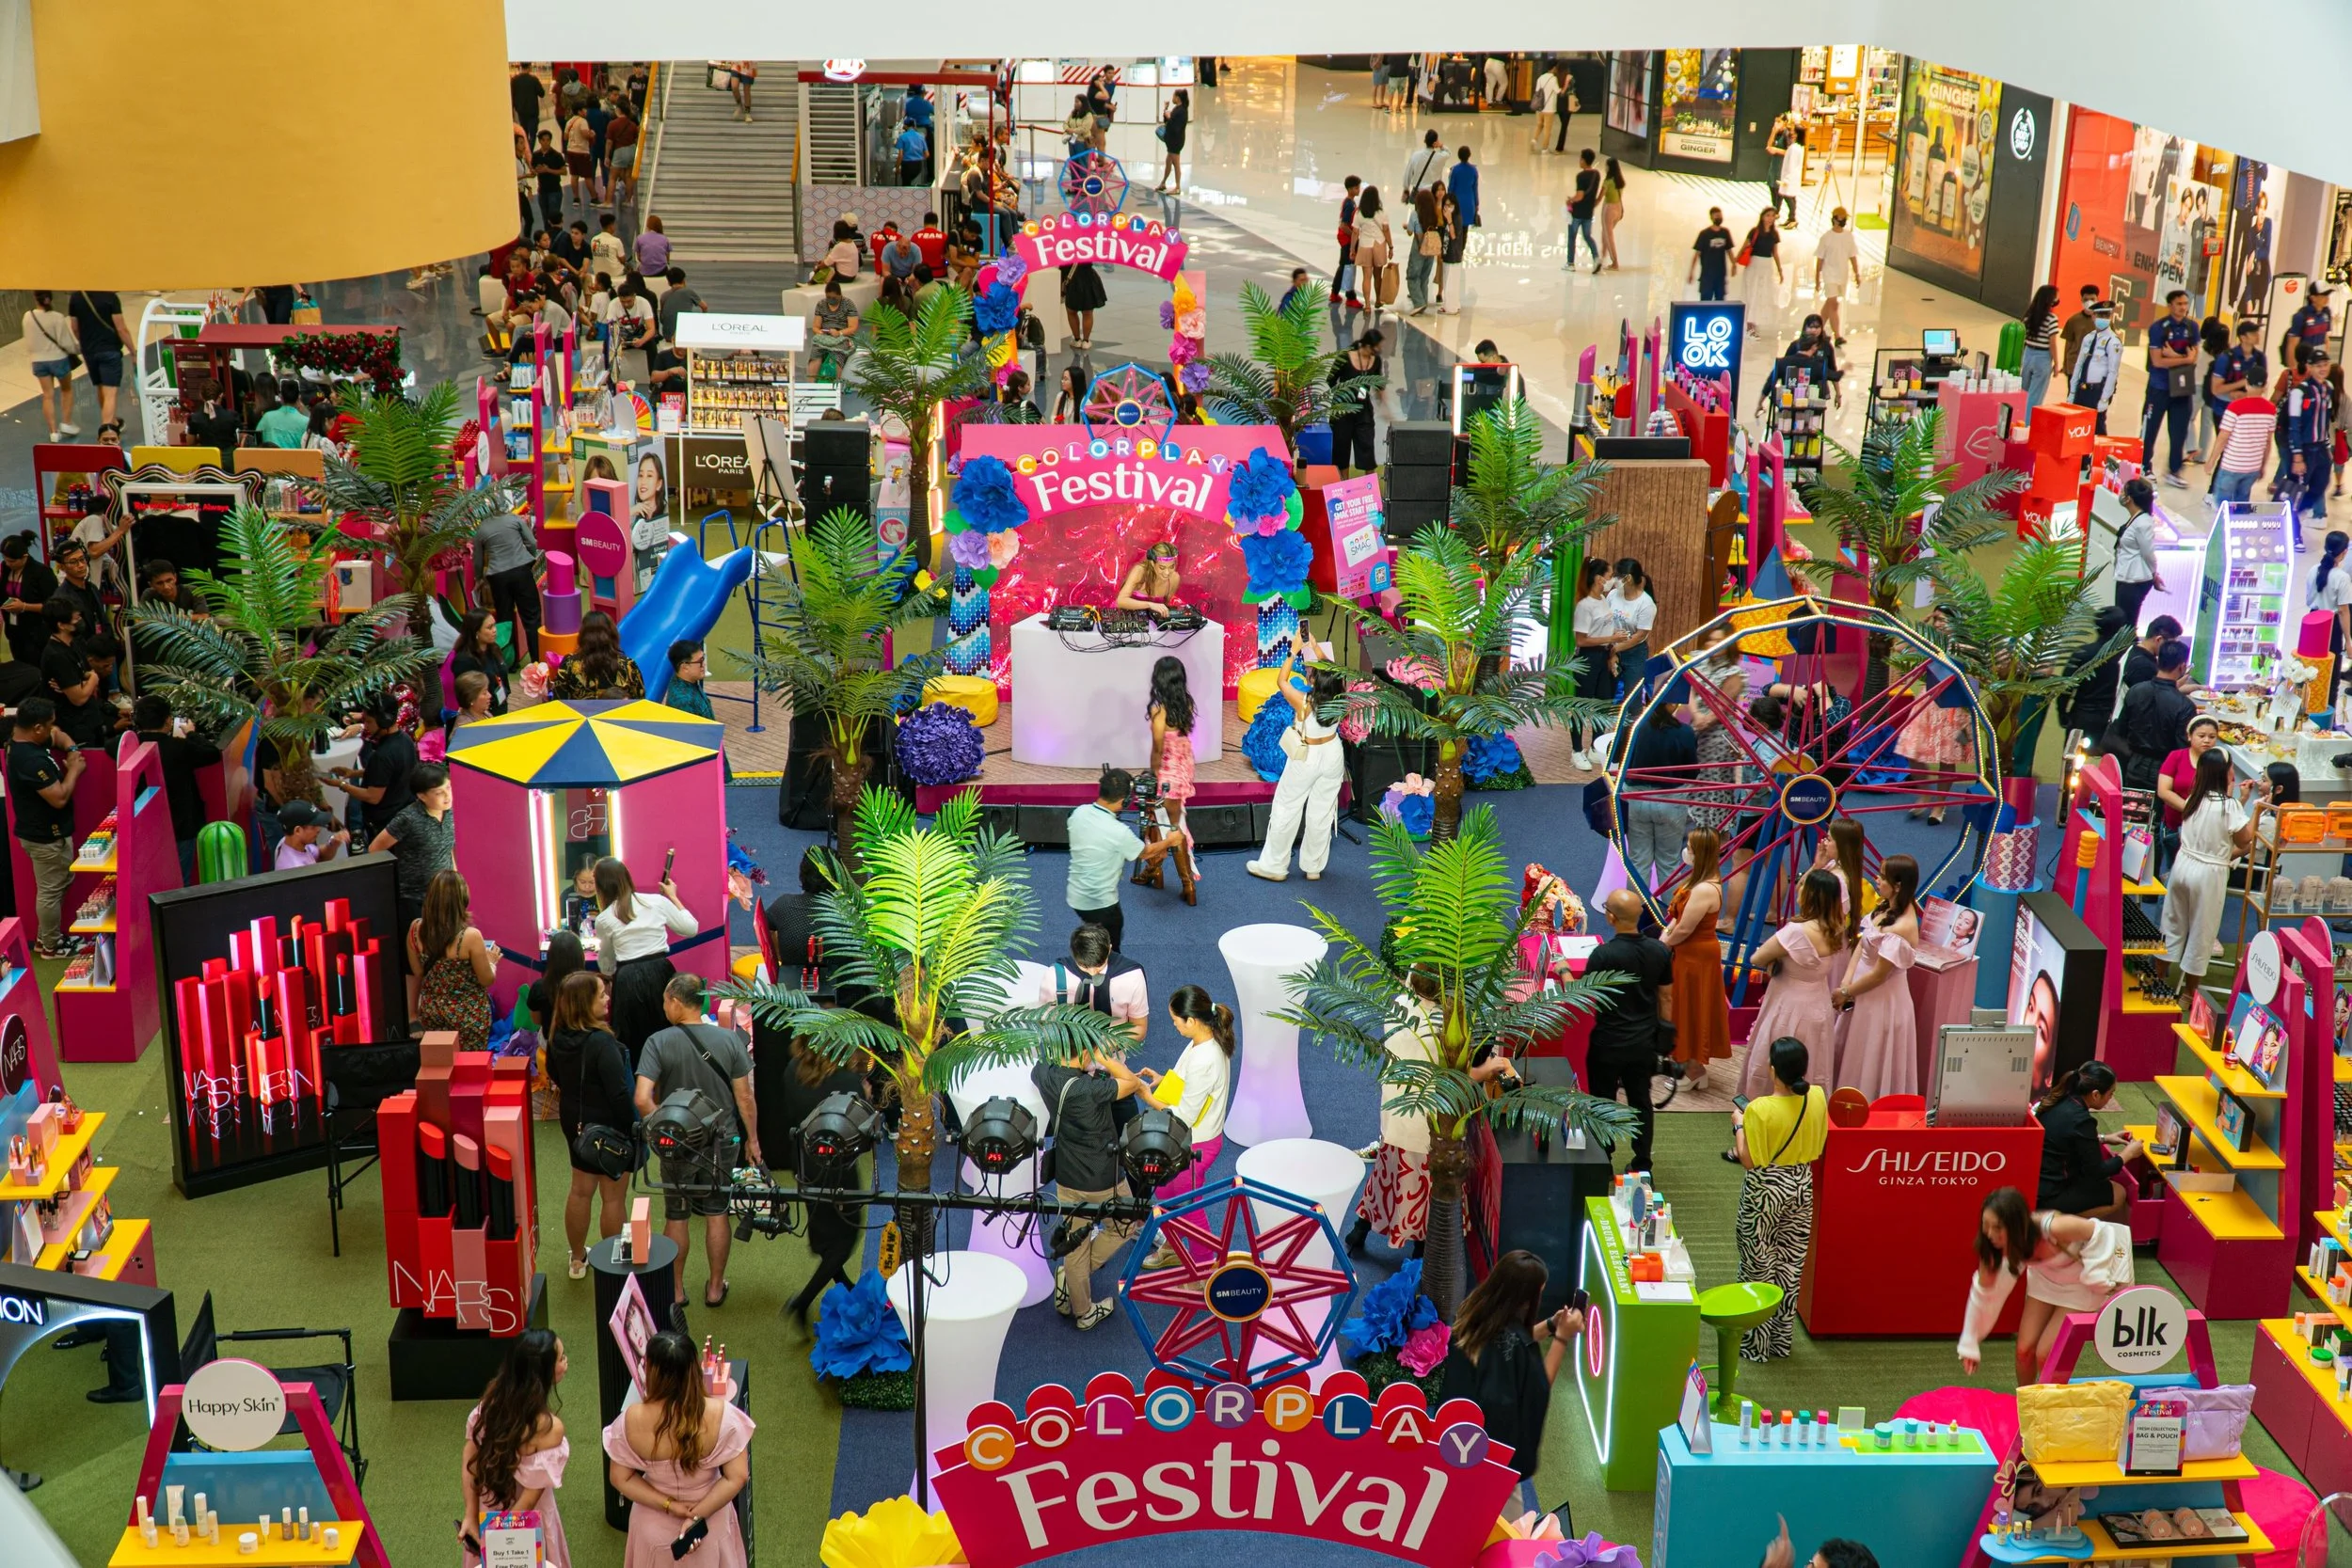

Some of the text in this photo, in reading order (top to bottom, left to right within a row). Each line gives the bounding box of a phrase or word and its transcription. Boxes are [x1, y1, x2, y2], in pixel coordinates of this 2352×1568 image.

[1929, 83, 1979, 111] GINGER
[1680, 144, 1716, 154] GINGER
[1025, 214, 1179, 243] COLORPLAY
[1032, 230, 1168, 273] Festival
[2133, 251, 2185, 284] ENHYPEN
[695, 454, 751, 467] L'ORÉA
[1018, 439, 1226, 474] COLORPLAY
[1029, 462, 1214, 513] Festival
[1346, 499, 1362, 509] YOUR
[1362, 495, 1375, 506] FREE
[1349, 507, 1365, 518] START
[580, 537, 621, 552] SMBEAUTY
[1350, 539, 1372, 556] SMAC
[2251, 952, 2277, 981] SHISEIDO
[1846, 1148, 2006, 1173] SHISEIDO
[1879, 1176, 1979, 1185] GINZA TOKYO
[1599, 1219, 1631, 1295] DRUNK ELEPHANT
[393, 1259, 517, 1334] NARS
[1216, 1287, 1262, 1298] SMBEAUTY
[2112, 1306, 2169, 1348] blk
[2117, 1350, 2161, 1358] COSMETICS
[188, 1399, 241, 1417] Happy
[971, 1391, 1483, 1465] COLORPLAY
[995, 1438, 1449, 1551] Festival
[496, 1519, 526, 1528] Festival
